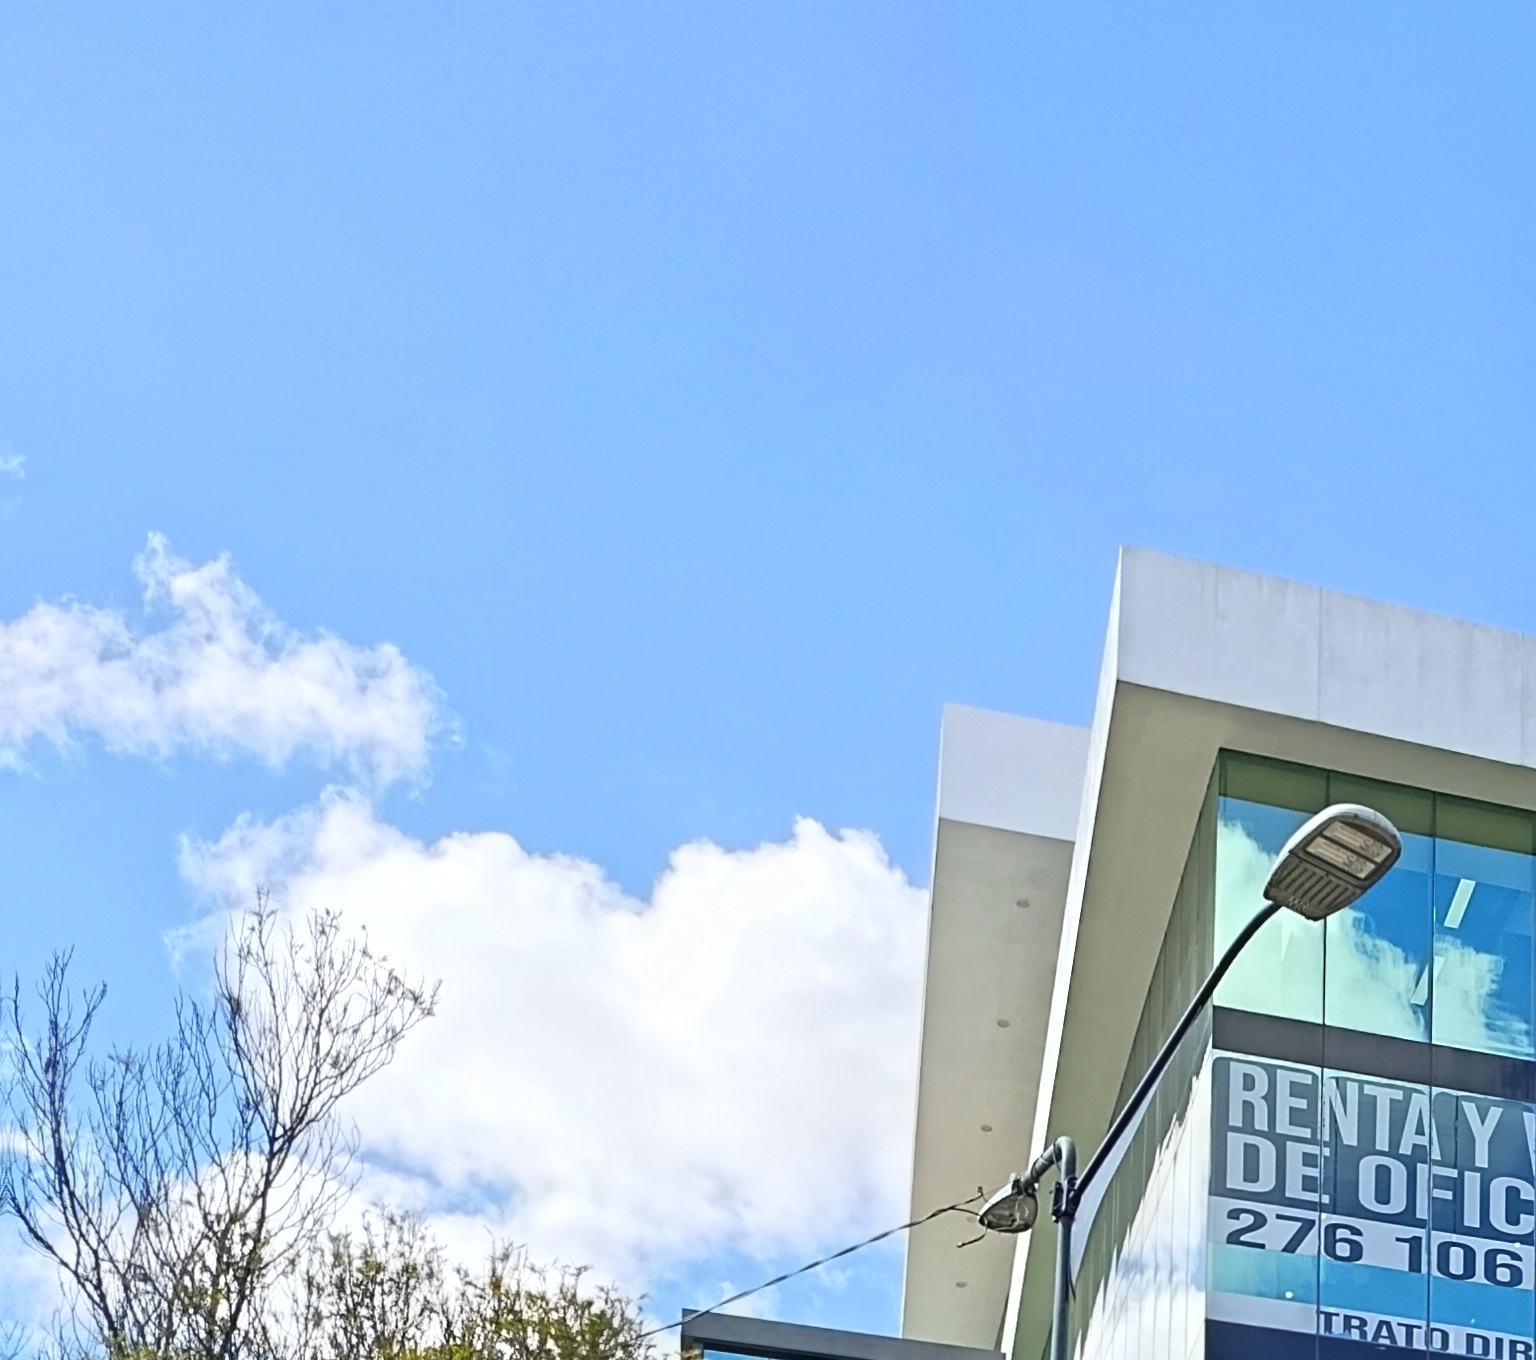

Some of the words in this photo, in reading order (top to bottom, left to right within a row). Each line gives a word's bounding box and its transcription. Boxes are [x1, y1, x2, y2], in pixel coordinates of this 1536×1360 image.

[1228, 1061, 1441, 1161] RENTA
[1461, 1101, 1503, 1168] Y
[1226, 1132, 1330, 1203] DE
[1226, 1207, 1364, 1262] 276
[1395, 1235, 1523, 1288] 106
[1320, 1310, 1449, 1353] TRATO
